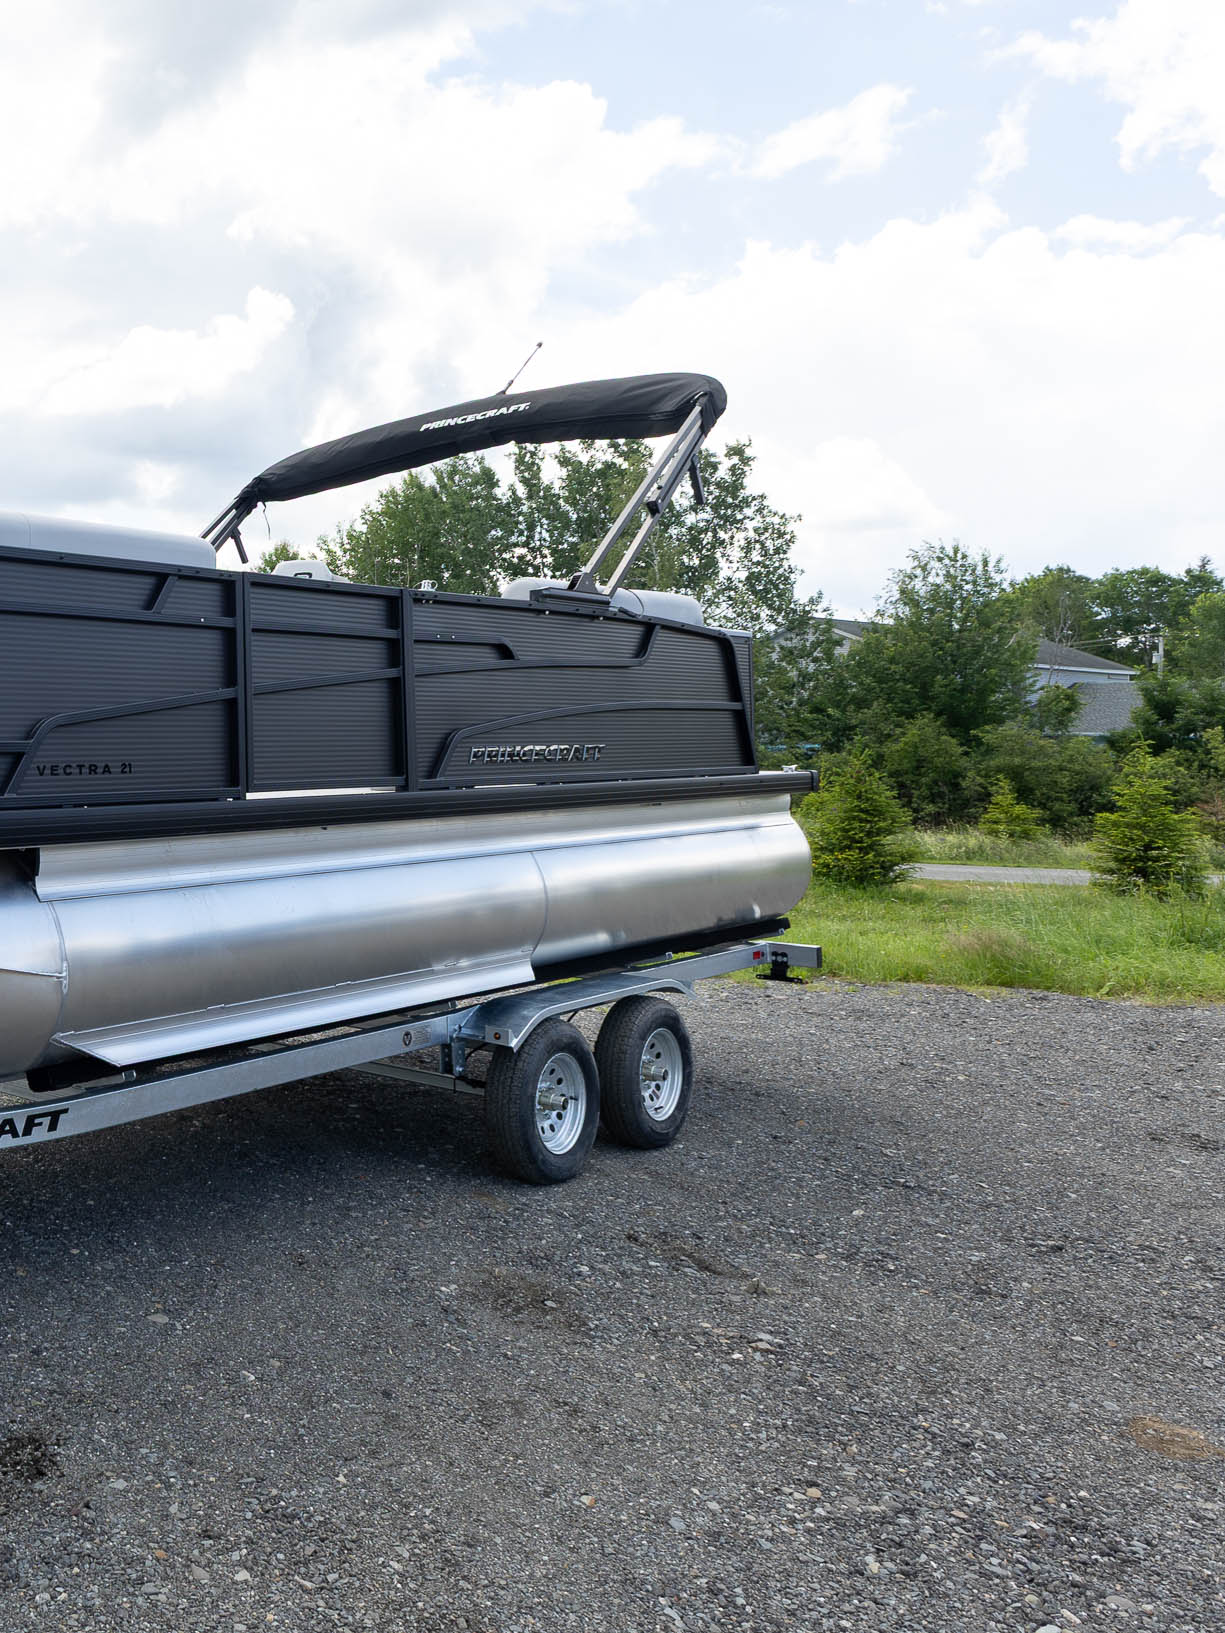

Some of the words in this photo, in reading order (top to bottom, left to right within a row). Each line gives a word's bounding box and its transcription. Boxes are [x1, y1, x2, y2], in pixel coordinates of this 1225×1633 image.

[469, 744, 606, 764] PRINCECRAFT
[36, 764, 112, 776] VECTRA
[120, 763, 132, 774] 21
